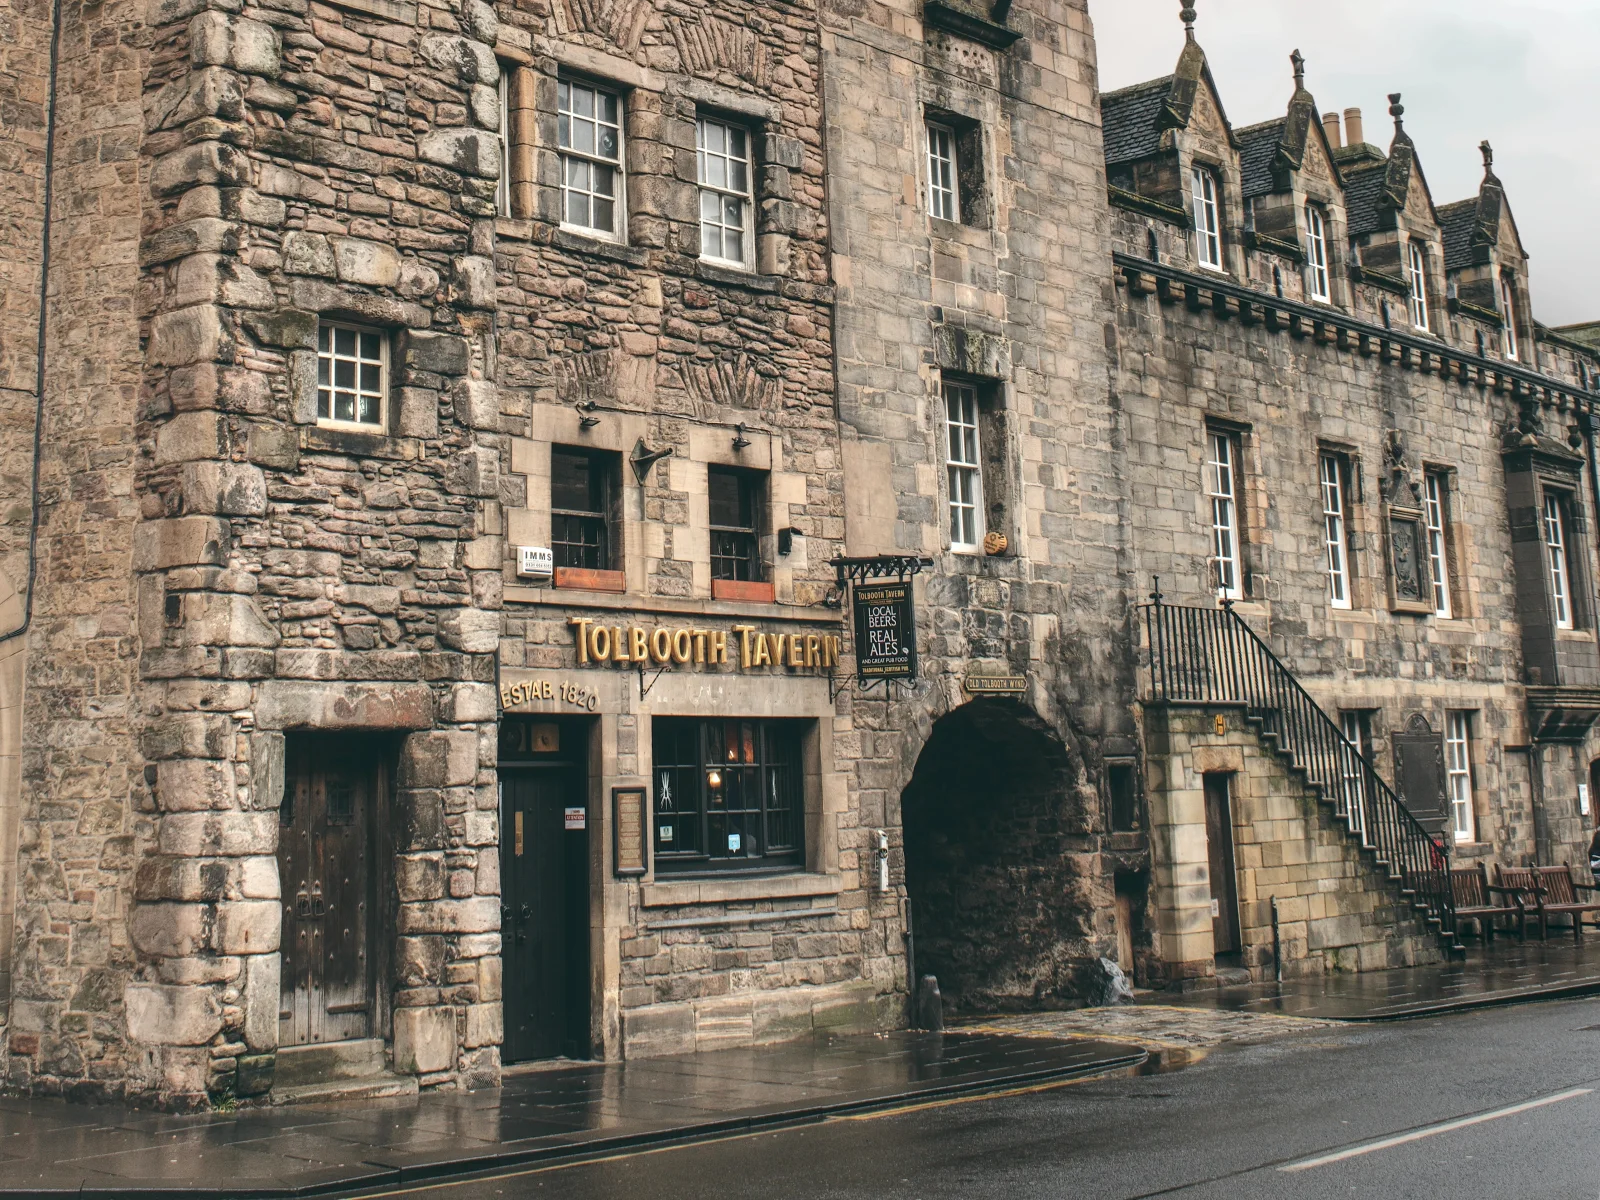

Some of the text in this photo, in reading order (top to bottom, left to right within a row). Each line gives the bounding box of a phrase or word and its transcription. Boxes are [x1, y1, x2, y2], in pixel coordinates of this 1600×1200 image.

[525, 551, 552, 561] IMMS
[858, 590, 905, 600] TOLBOOTH TAVERN
[868, 606, 896, 616] LOCAL
[869, 616, 897, 628] BEERS
[568, 616, 840, 668] TOLBOOTH TAVERN
[869, 630, 897, 643] REAL
[870, 642, 898, 656] ALES
[970, 679, 979, 688] OLD
[981, 679, 1007, 688] TOLBOOTH
[559, 680, 599, 711] 1820
